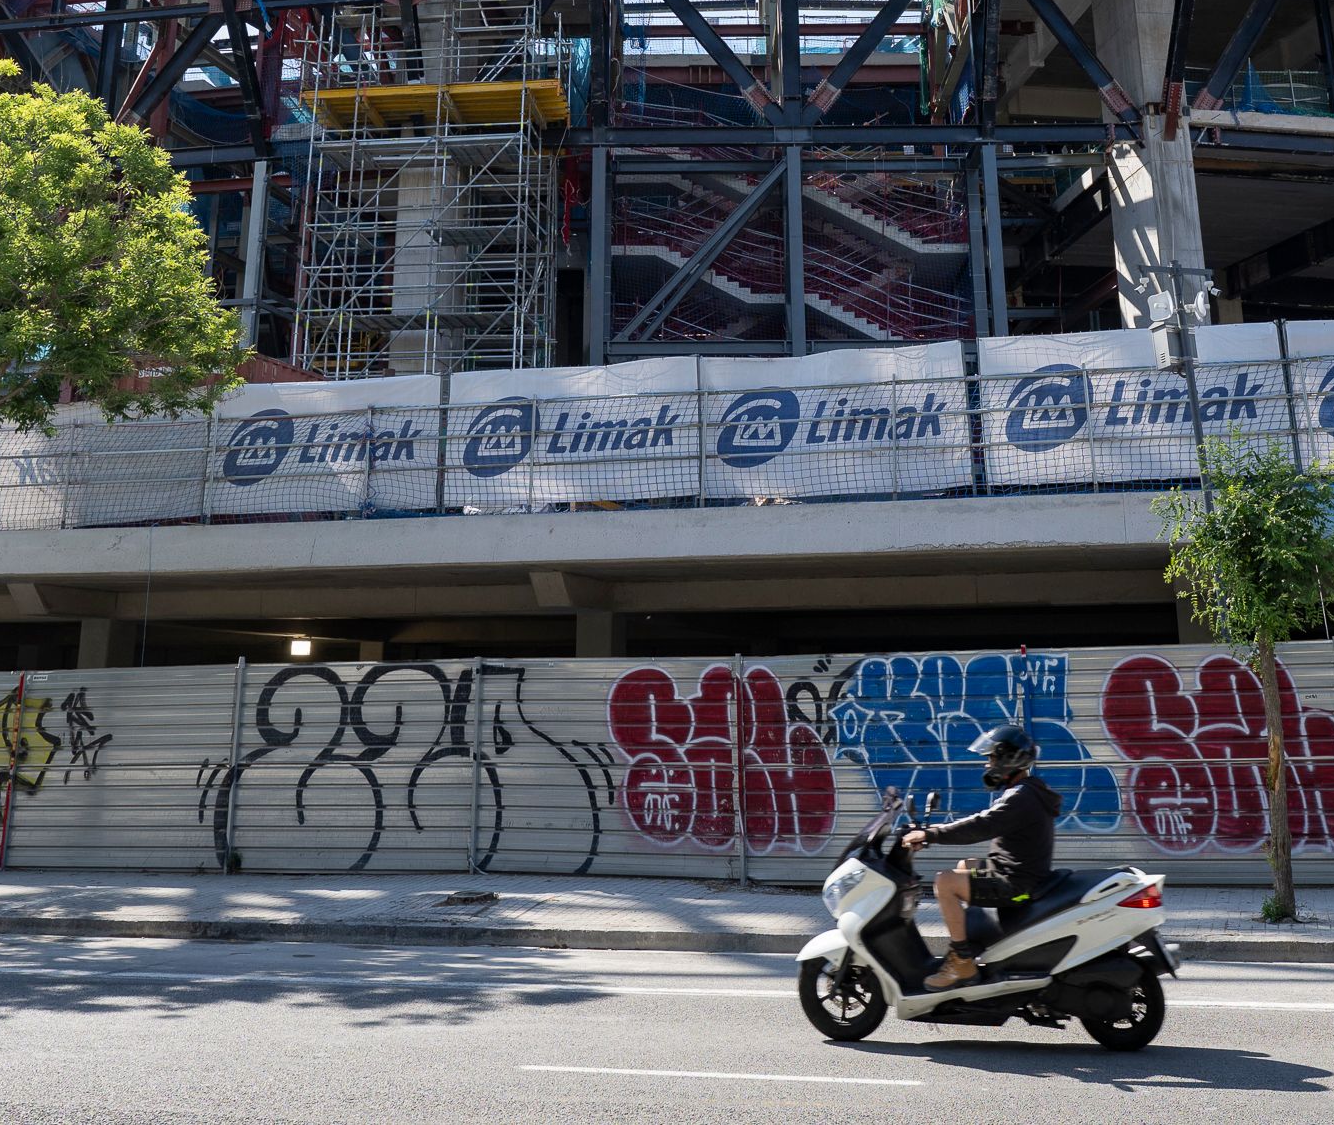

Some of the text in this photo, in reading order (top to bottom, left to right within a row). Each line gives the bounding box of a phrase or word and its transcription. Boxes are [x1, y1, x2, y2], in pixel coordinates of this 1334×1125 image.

[805, 392, 947, 445] Limak
[1103, 372, 1265, 427] Limak
[299, 419, 423, 463] Limak
[546, 405, 681, 455] Limak
